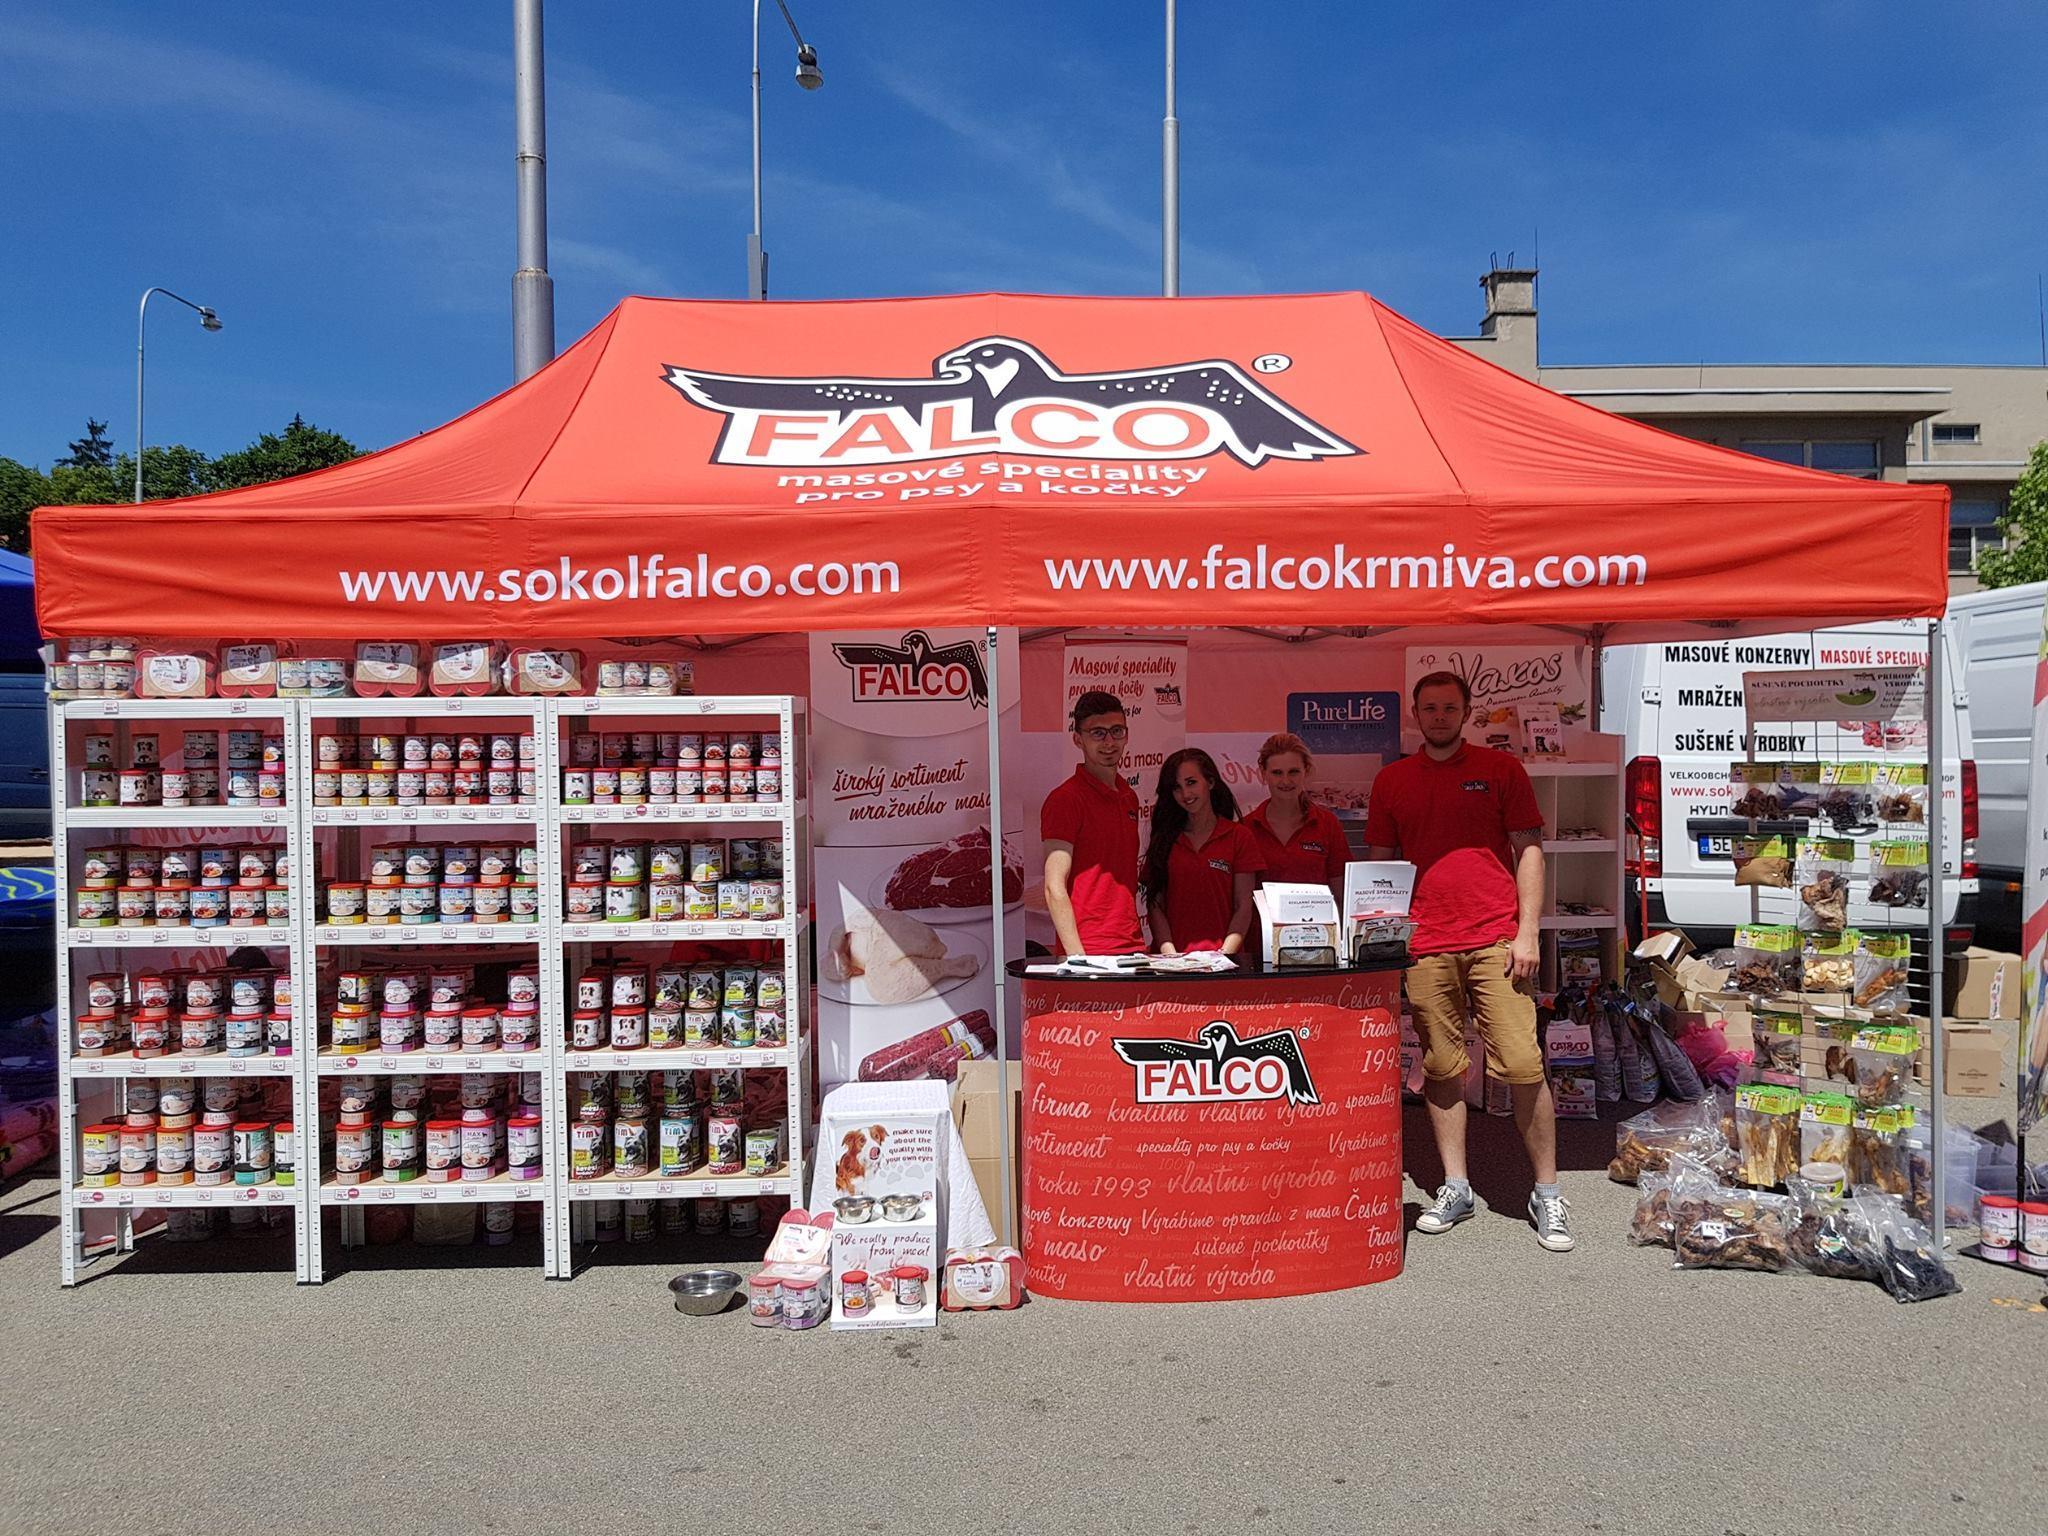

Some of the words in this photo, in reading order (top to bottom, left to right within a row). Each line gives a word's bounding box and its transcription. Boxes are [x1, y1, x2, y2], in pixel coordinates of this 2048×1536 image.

[745, 403, 1210, 456] FALCO
[777, 462, 966, 488] masové
[979, 461, 1208, 482] speciality
[795, 487, 884, 504] pro
[900, 482, 983, 500] psy
[998, 480, 1023, 493] a
[1039, 480, 1187, 498] kočky
[339, 553, 901, 602] www.sokolfalco.com
[1044, 543, 1647, 590] www.falcokrmiva.com
[1069, 655, 1120, 677] Masové
[1122, 656, 1177, 677] speciality
[1665, 642, 1729, 663] MASOVÉ
[1735, 647, 1810, 665] KONZERVY
[1820, 647, 1872, 664] MASOVÉ
[859, 666, 967, 696] FALCO
[1069, 684, 1087, 700] pro
[1118, 680, 1145, 700] kočky
[1302, 697, 1386, 721] PureLife
[1675, 729, 1734, 751] SUŠENÉ
[1134, 752, 1163, 767] masa
[832, 766, 885, 796] široký
[891, 758, 968, 790] sortiment
[849, 790, 946, 821] mraženého
[1337, 978, 1383, 1009] Česká
[1053, 993, 1126, 1021] konzervy
[1136, 992, 1208, 1020] Vyrábíme
[1215, 992, 1277, 1018] opravdu
[1300, 994, 1337, 1007] masa
[1040, 1025, 1101, 1047] maso
[1144, 1060, 1283, 1096] FALCO
[1032, 1082, 1092, 1118] firma
[1107, 1098, 1189, 1123] kvalitní
[1200, 1101, 1268, 1123] vlastní
[1344, 1084, 1397, 1110] speciality
[893, 1128, 914, 1136] make
[894, 1137, 911, 1145] about
[1136, 1137, 1192, 1157] speciality
[1197, 1143, 1217, 1157] pro
[1222, 1142, 1241, 1156] psy
[1247, 1143, 1255, 1151] a
[1260, 1135, 1291, 1153] kočky
[1329, 1131, 1388, 1158] Vyrábíme
[886, 1157, 900, 1165] your
[918, 1155, 934, 1164] eyes
[888, 1146, 914, 1156] quality
[916, 1146, 933, 1154] with
[1038, 1170, 1082, 1196] roku
[1091, 1176, 1152, 1200] 1993
[1168, 1160, 1250, 1194] vlastní
[1262, 1158, 1337, 1200] výroba
[1058, 1207, 1132, 1237] konzervy
[1141, 1207, 1215, 1235] Vyrábíme
[1222, 1206, 1281, 1233] opravdu
[1288, 1208, 1298, 1221] z
[1305, 1205, 1341, 1220] masa
[1344, 1188, 1388, 1221] Česká
[860, 1233, 888, 1247] really
[894, 1234, 931, 1246] produce
[869, 1245, 895, 1259] from
[1043, 1239, 1107, 1262] maso
[1192, 1235, 1246, 1256] sušené
[1252, 1228, 1330, 1261] pochoutky
[1368, 1250, 1400, 1271] 1993
[1124, 1258, 1198, 1289] vlastní
[1207, 1260, 1276, 1295] výroba
